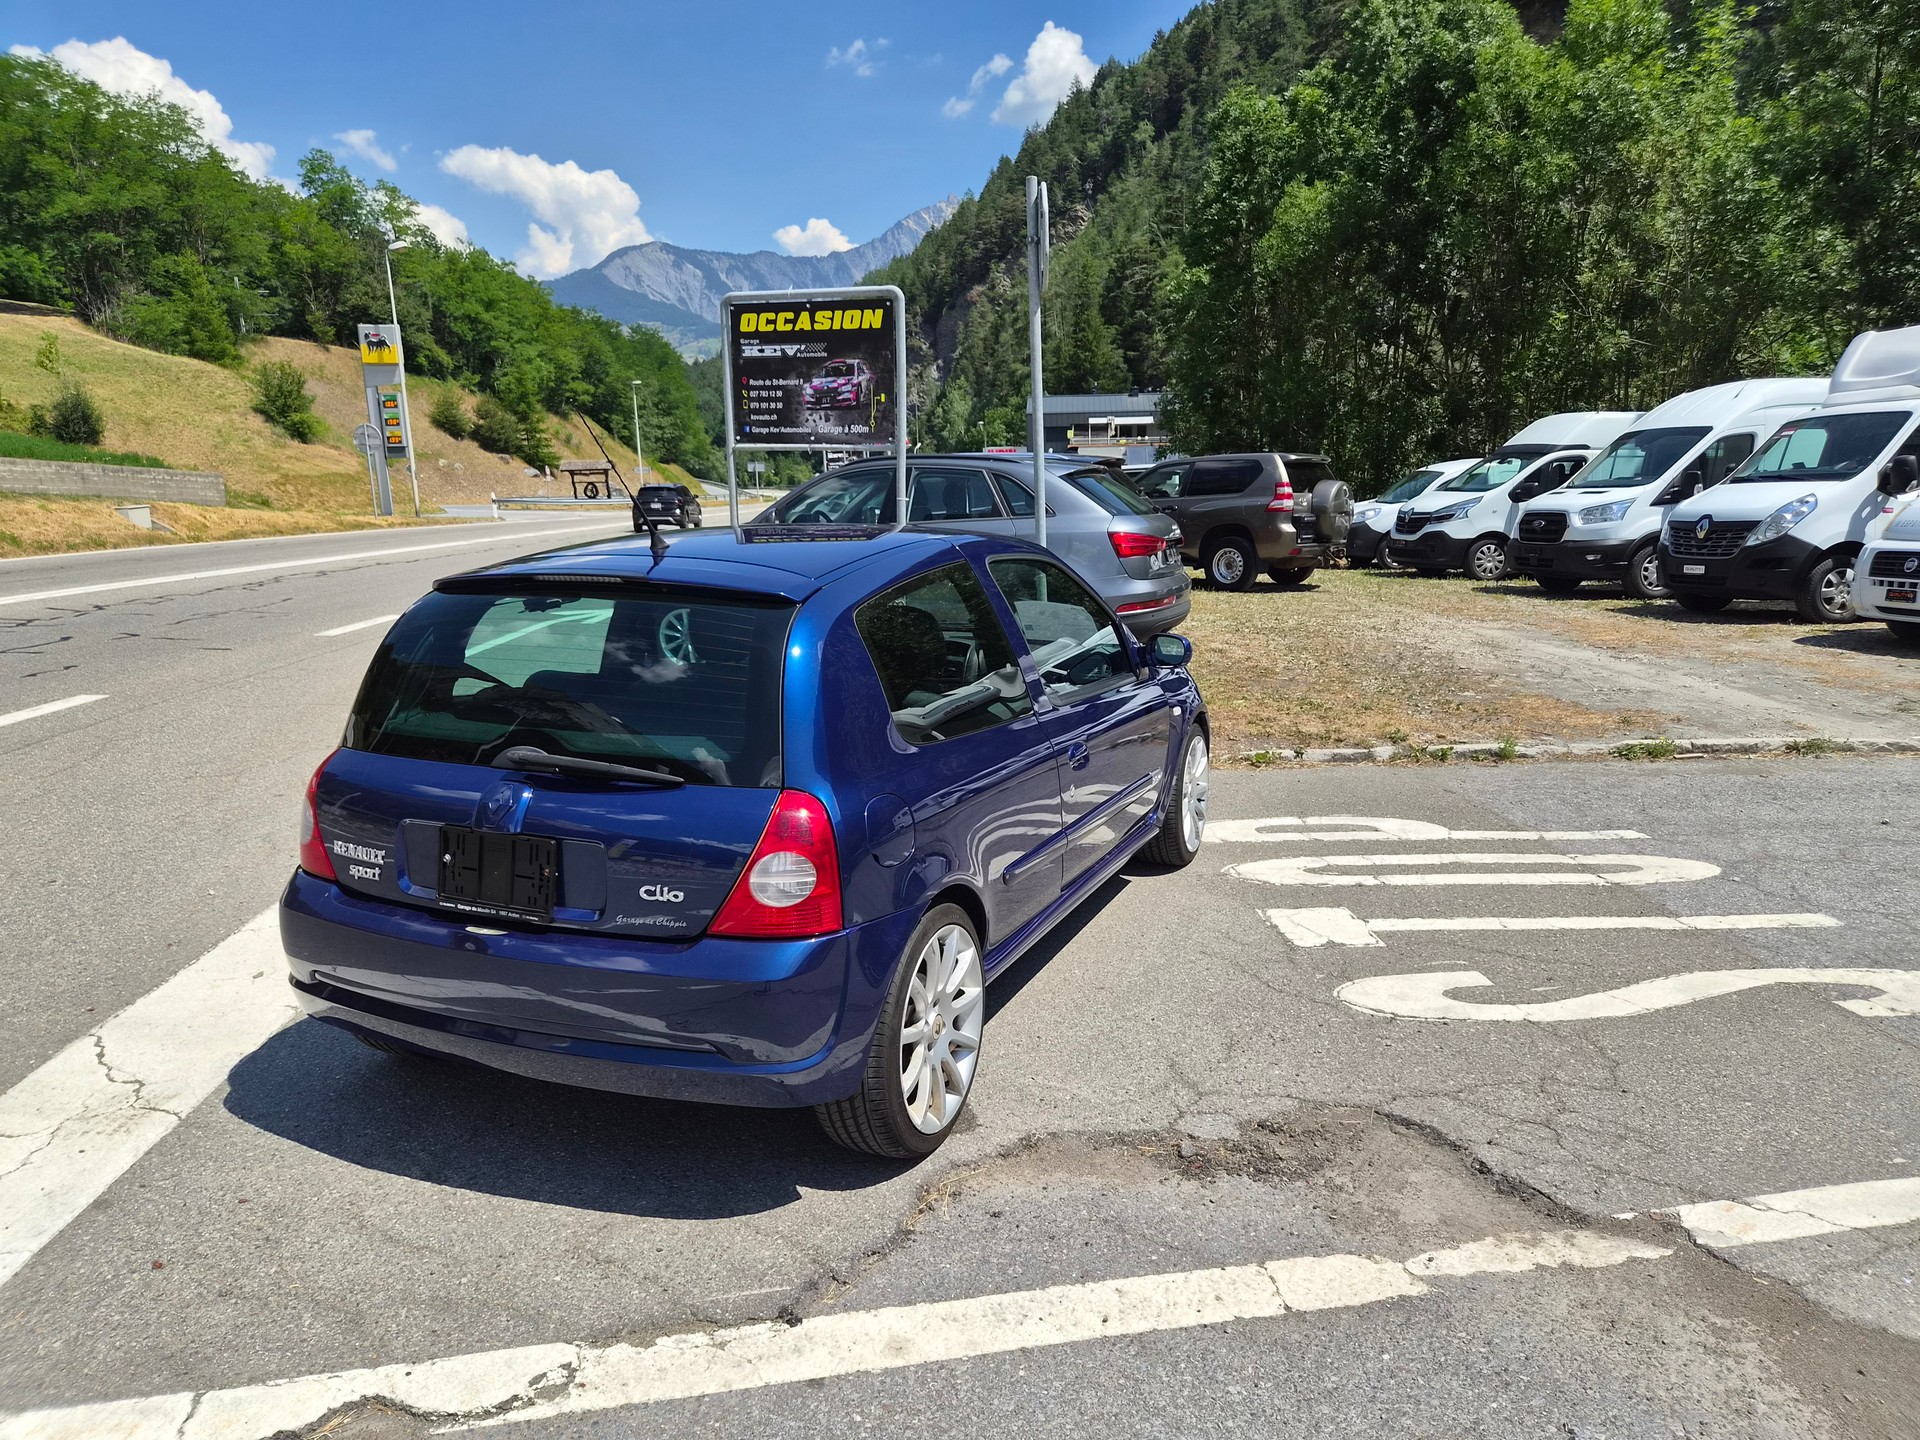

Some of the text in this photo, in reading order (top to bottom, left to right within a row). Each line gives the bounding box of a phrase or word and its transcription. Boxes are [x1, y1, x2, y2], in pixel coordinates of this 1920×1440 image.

[740, 308, 884, 332] OCCASION
[749, 378, 764, 386] Route
[772, 378, 799, 386] St-Bernard
[750, 390, 759, 398] 027
[770, 390, 775, 398] 12
[750, 413, 778, 421] kevauto.ch
[751, 426, 770, 434] Garage
[818, 424, 870, 435] Garage à 500m
[333, 840, 386, 865] RENAULT
[349, 864, 381, 881] sport
[639, 884, 684, 903] Clio
[457, 903, 472, 911] Garage
[477, 906, 491, 914] Moulin
[616, 915, 643, 925] Garage
[656, 918, 686, 928] Chippis
[1201, 816, 1920, 1022] STOP
